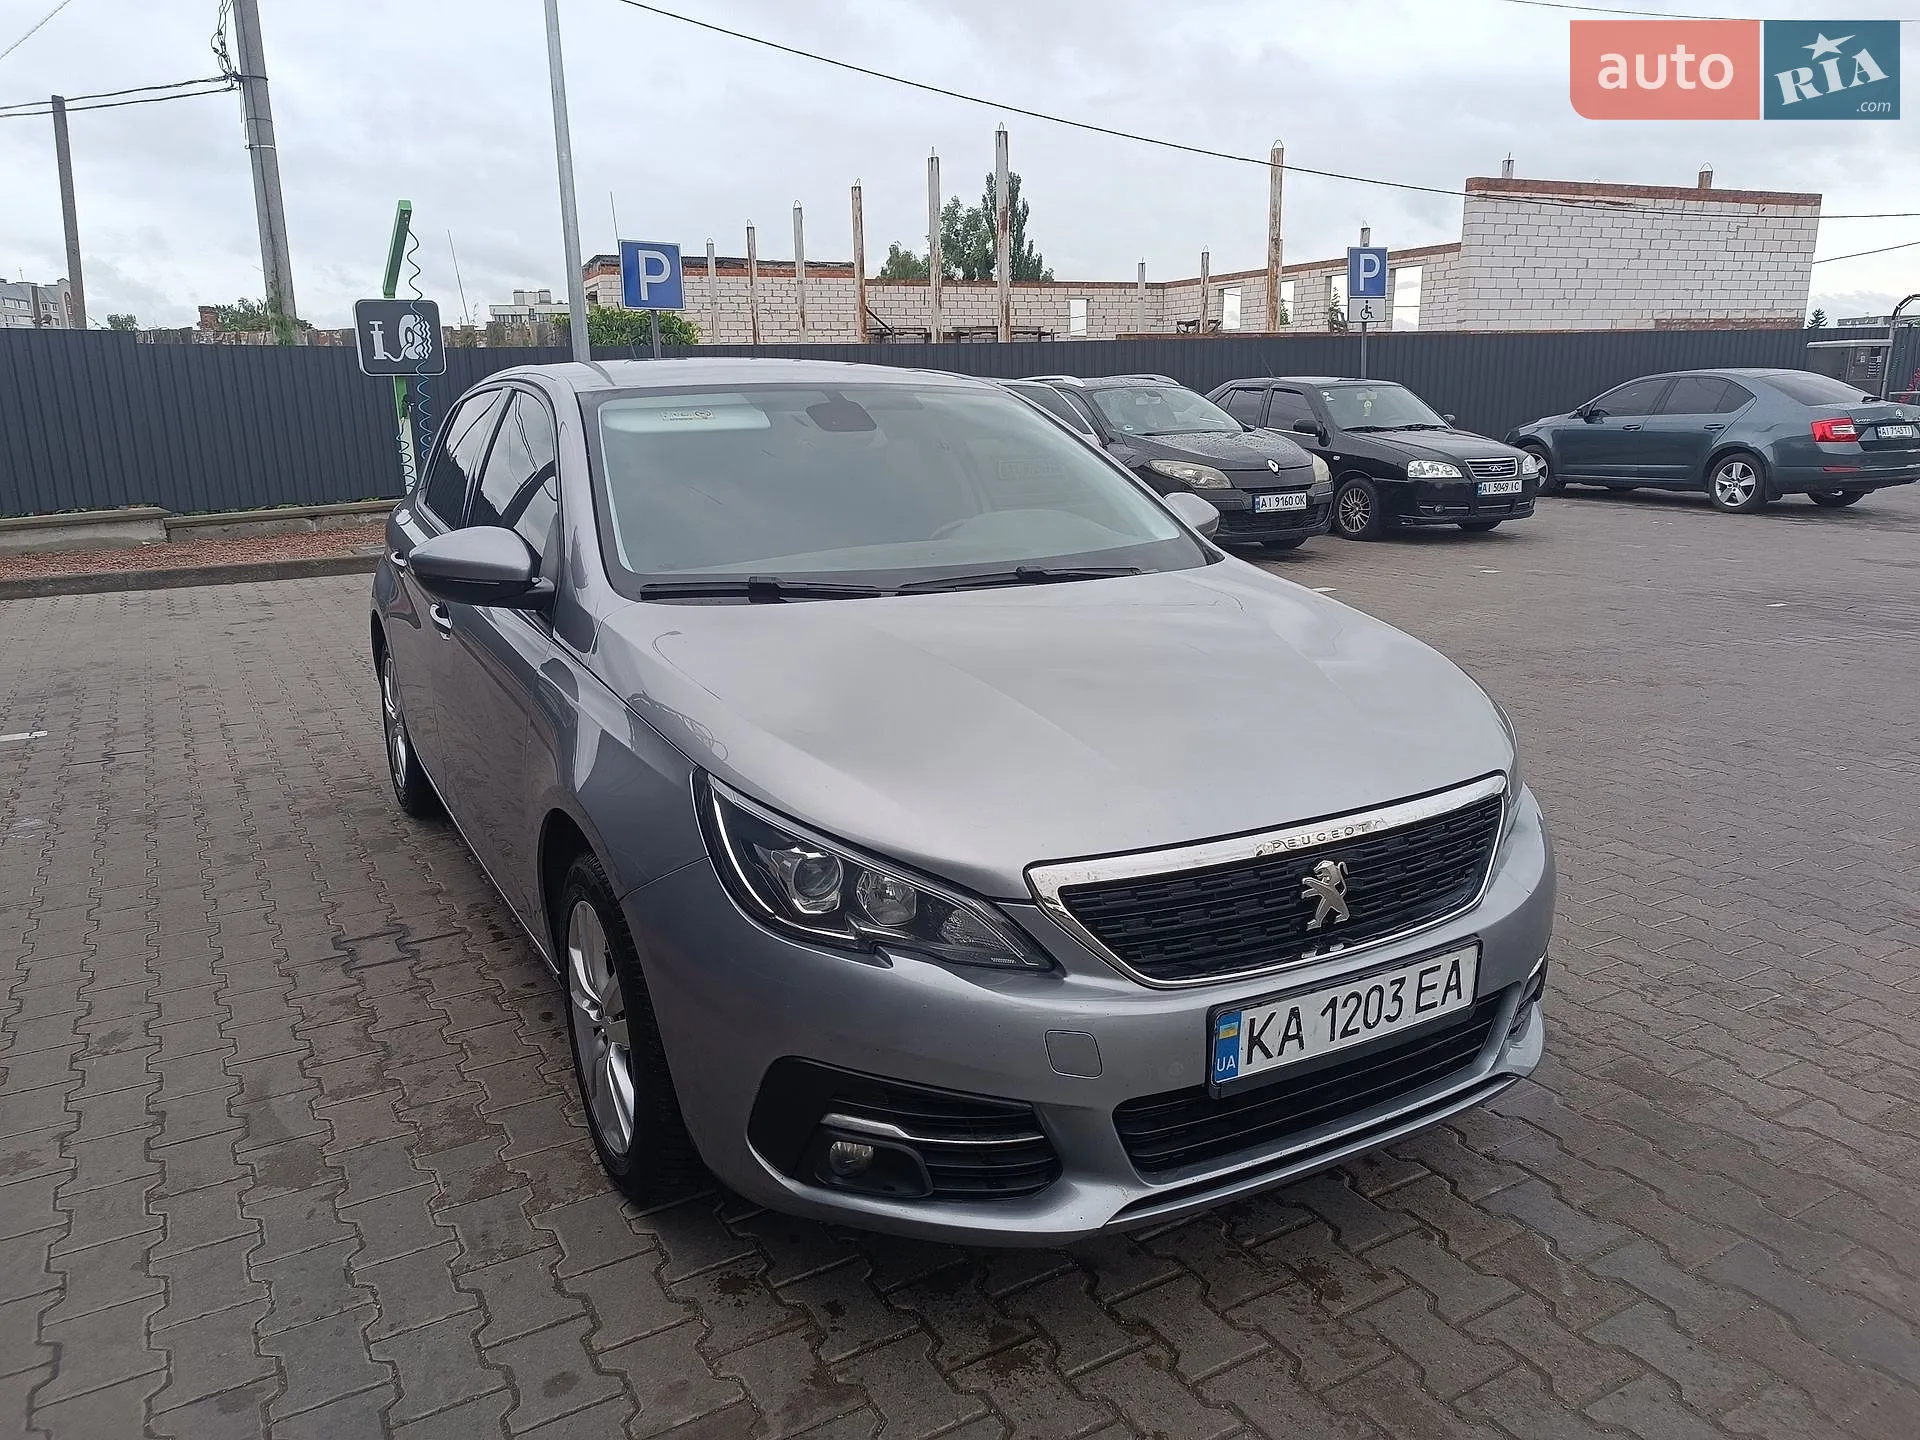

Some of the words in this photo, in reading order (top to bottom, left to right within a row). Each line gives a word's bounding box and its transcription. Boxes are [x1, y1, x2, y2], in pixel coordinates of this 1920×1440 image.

[638, 249, 671, 301] P
[1359, 253, 1380, 291] P
[1261, 497, 1272, 509] AI
[1275, 495, 1294, 507] 9160
[1295, 494, 1306, 506] OK
[1272, 824, 1367, 849] PEUGEOT
[1246, 1005, 1305, 1066] KA
[1320, 976, 1407, 1043] 1203
[1415, 958, 1463, 1015] EA
[1216, 1055, 1236, 1072] UA
